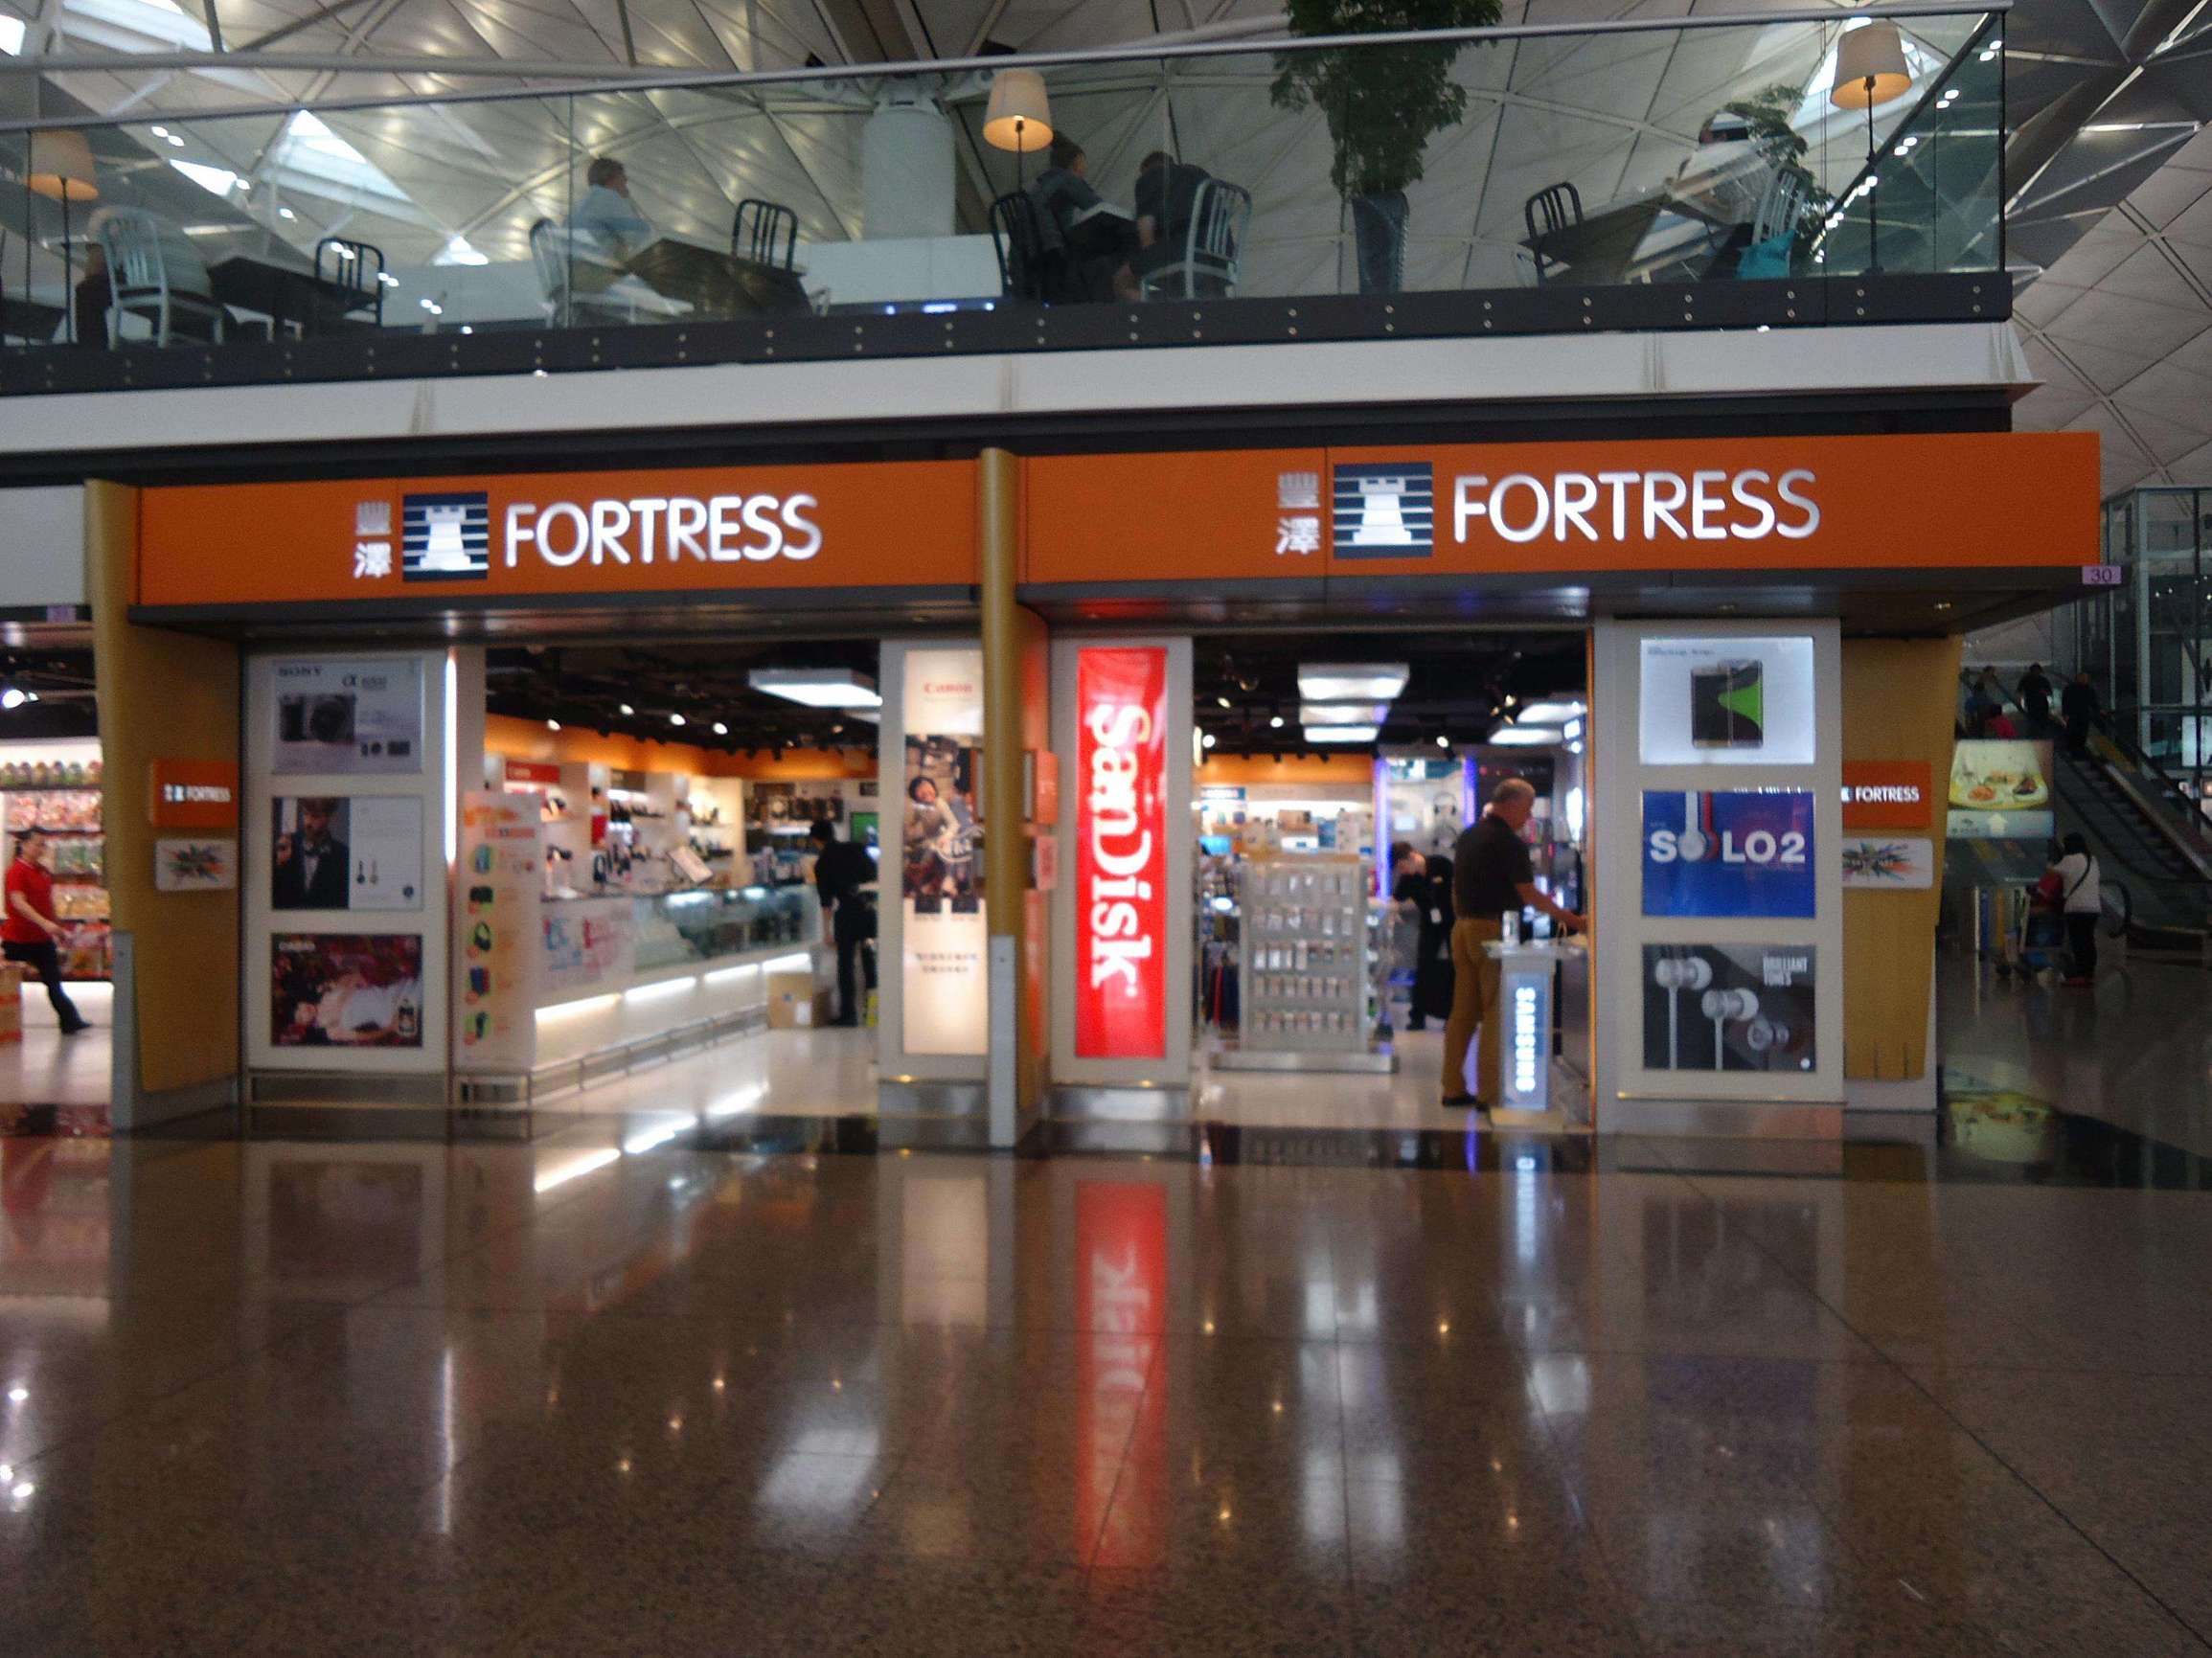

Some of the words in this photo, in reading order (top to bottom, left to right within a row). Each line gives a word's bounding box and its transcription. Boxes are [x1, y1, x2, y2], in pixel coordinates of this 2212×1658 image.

[505, 494, 822, 567] FORTRESS
[1453, 469, 1821, 544] FORTRESS
[2091, 568, 2113, 583] 30
[187, 785, 231, 803] FORTRESS
[1855, 785, 1920, 803] FORTRESS
[1091, 704, 1152, 989] SanDisk
[1515, 987, 1536, 1092] SAMSUNG
